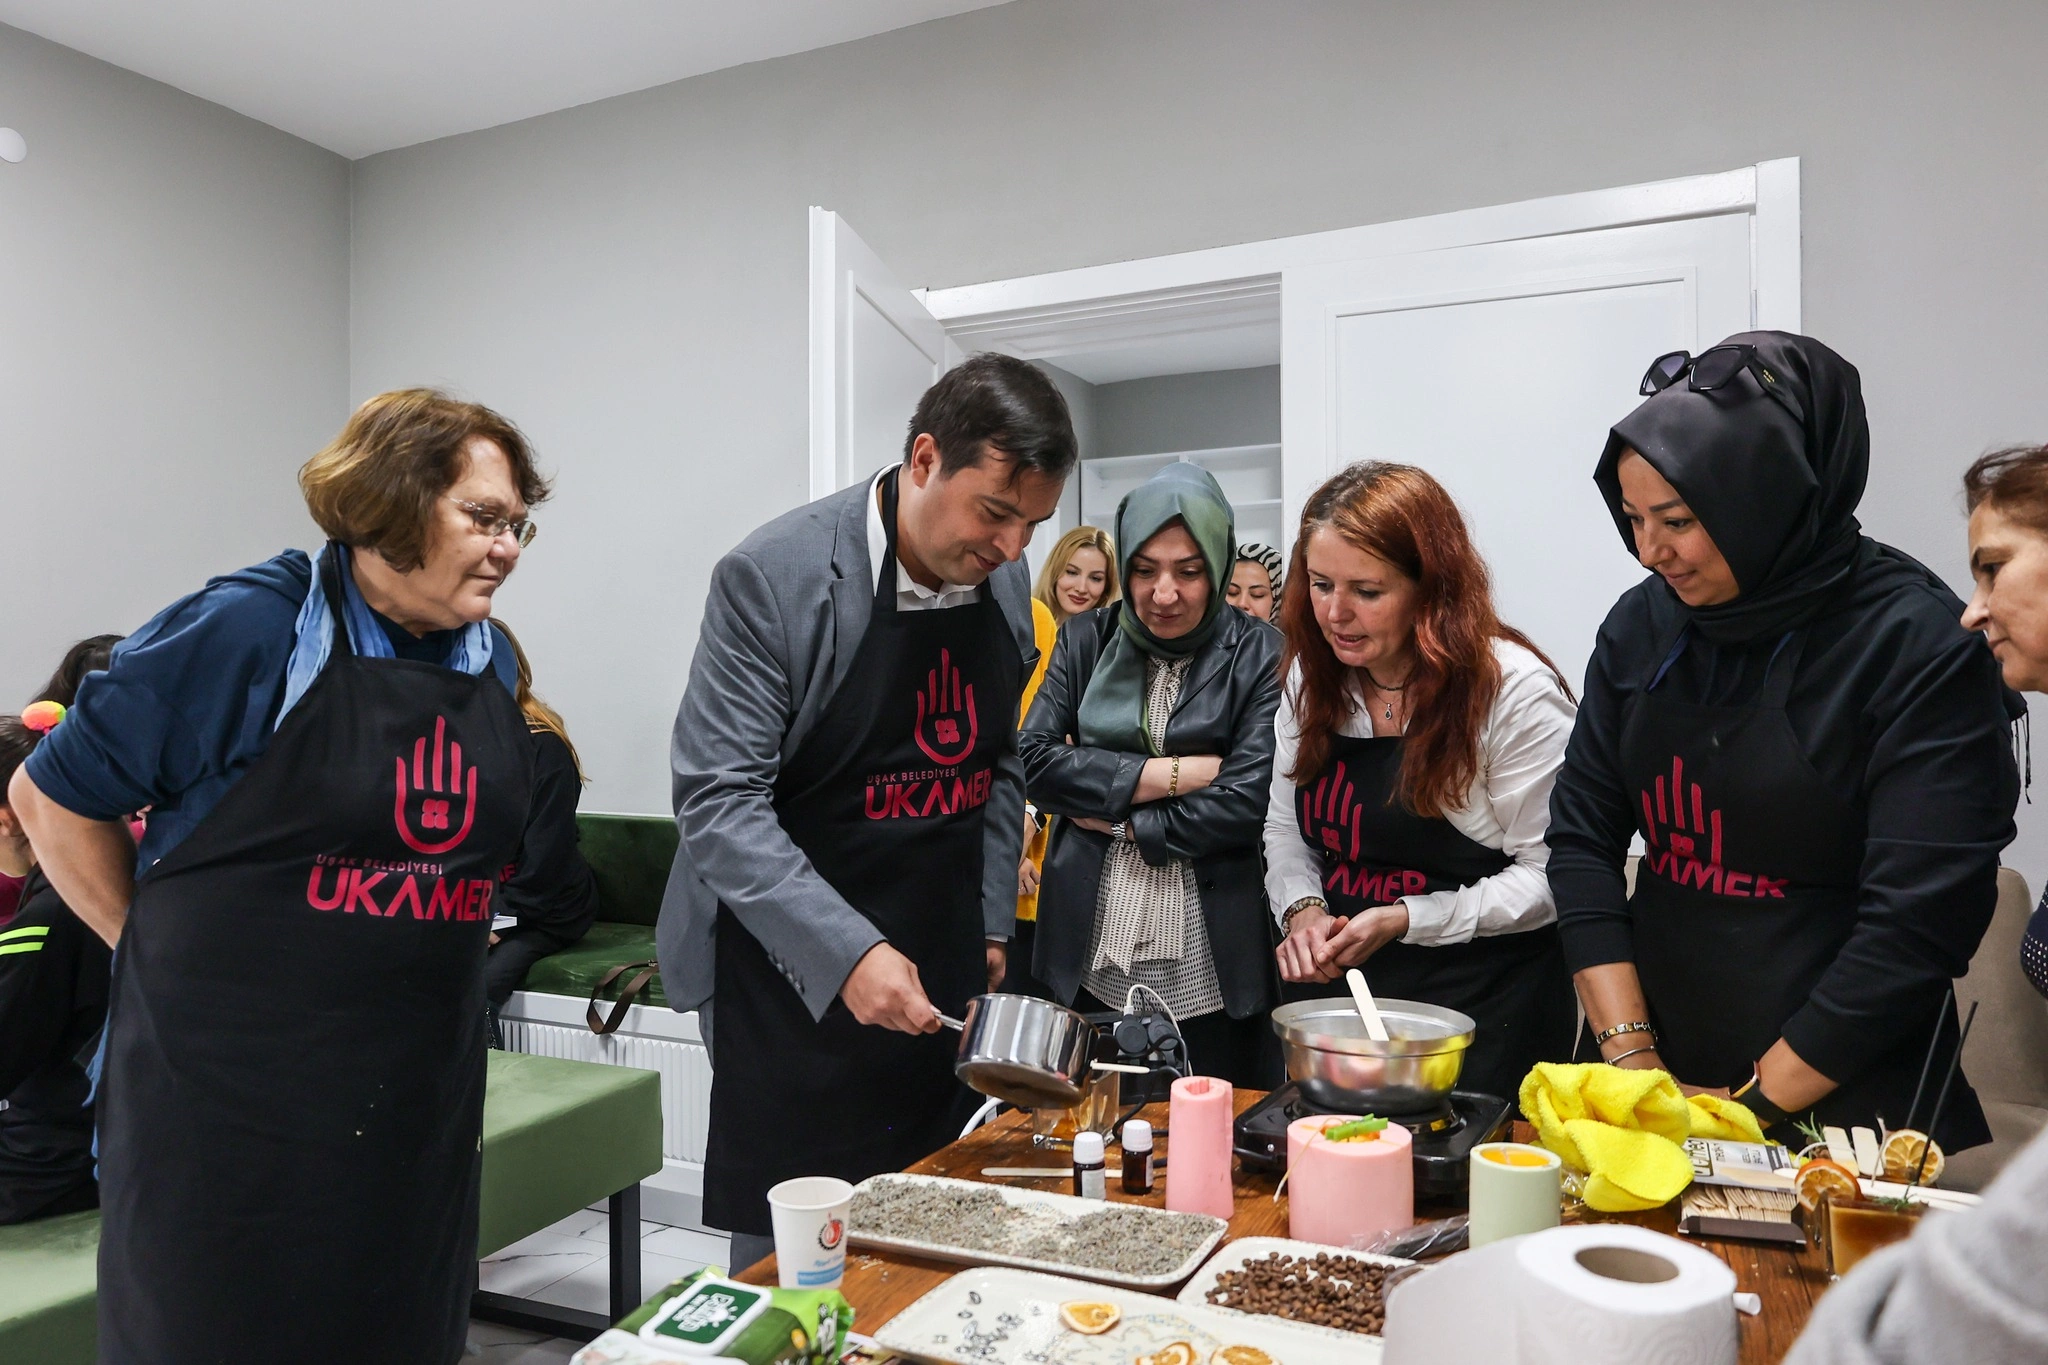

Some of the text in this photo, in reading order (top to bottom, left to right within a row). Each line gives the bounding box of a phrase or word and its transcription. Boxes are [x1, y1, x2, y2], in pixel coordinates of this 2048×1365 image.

[864, 767, 991, 820] UKAMER
[867, 766, 959, 785] UŞAK BELEDİYESİ
[316, 854, 443, 875] UŞAK BELEDİYESİ
[1324, 862, 1427, 902] AMER
[307, 866, 493, 921] UKAMER
